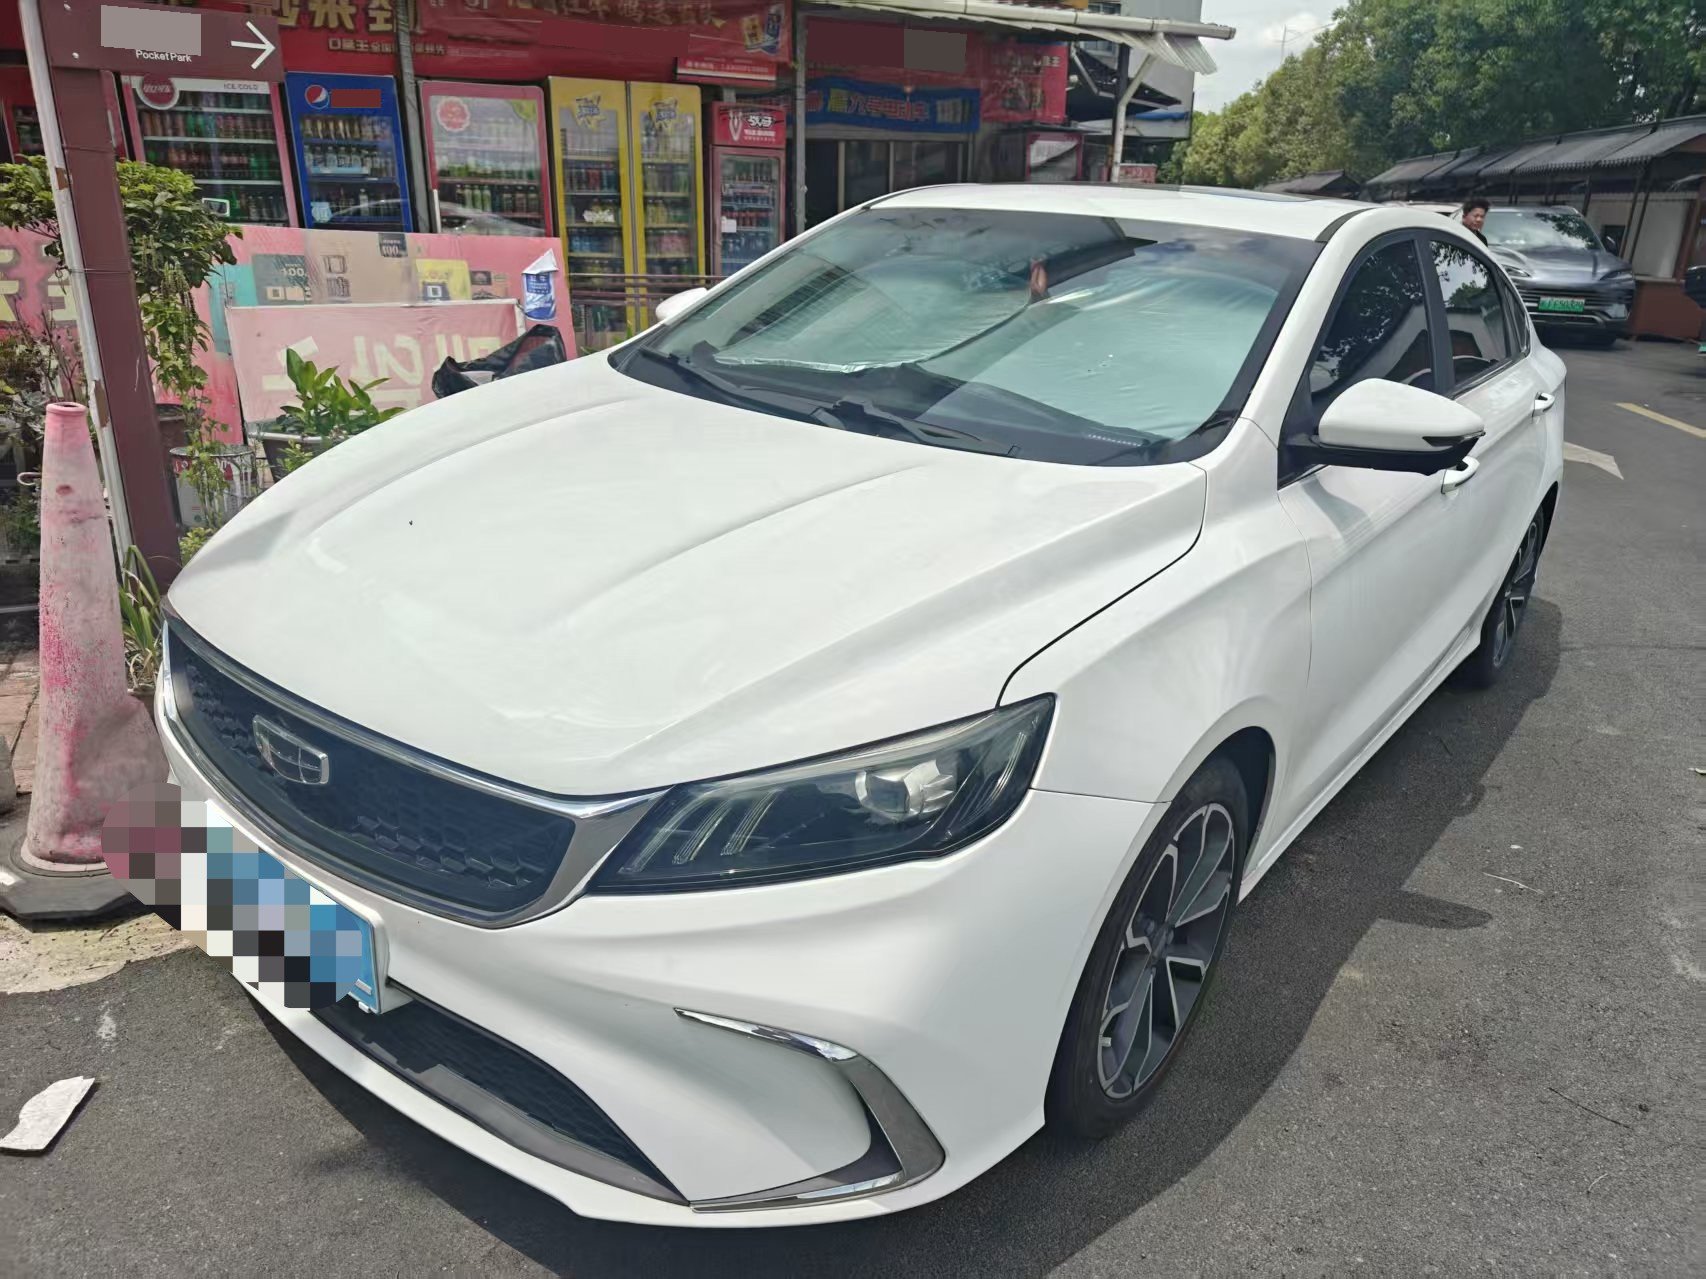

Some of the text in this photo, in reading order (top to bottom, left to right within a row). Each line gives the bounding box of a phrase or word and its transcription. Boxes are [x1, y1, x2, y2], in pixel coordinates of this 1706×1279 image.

[135, 49, 192, 63] Pocket Park
[238, 83, 259, 91] COLD
